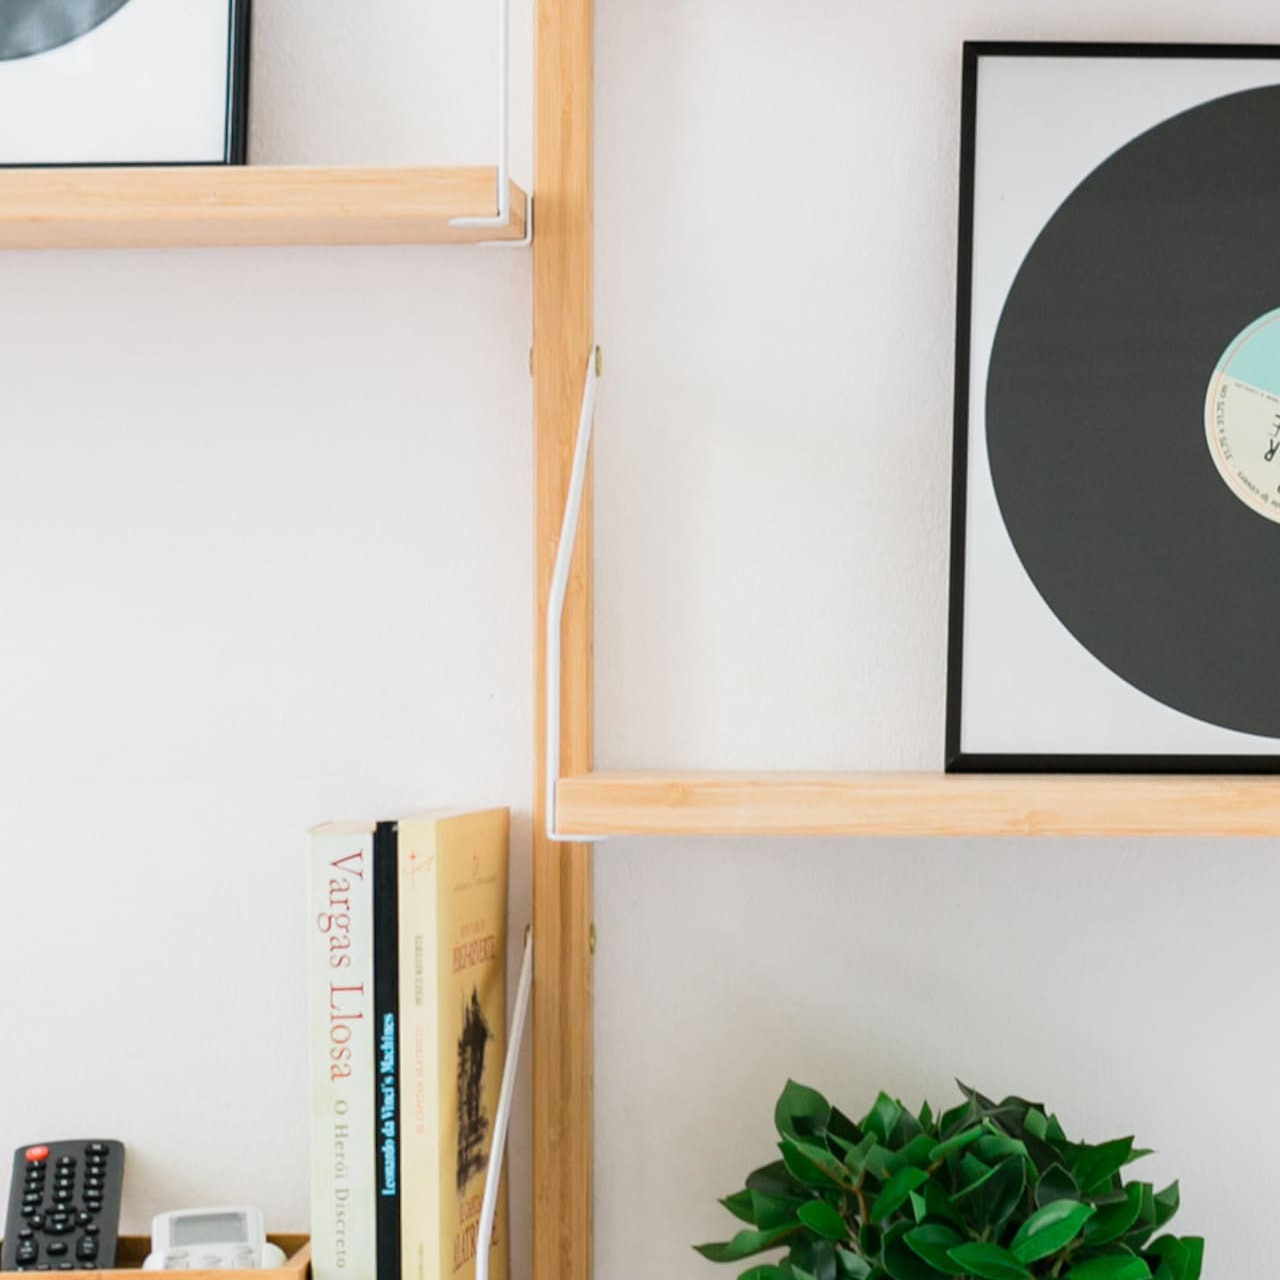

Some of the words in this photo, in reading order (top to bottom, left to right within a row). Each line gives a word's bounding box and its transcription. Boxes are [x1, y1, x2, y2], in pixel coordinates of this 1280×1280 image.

[316, 850, 364, 969] Vargas
[329, 981, 365, 1082] Llosa
[334, 1099, 348, 1115] O
[381, 1120, 395, 1137] da
[334, 1124, 349, 1180] Herói
[381, 1138, 396, 1196] Leonardo
[335, 1188, 349, 1269] Discreto
